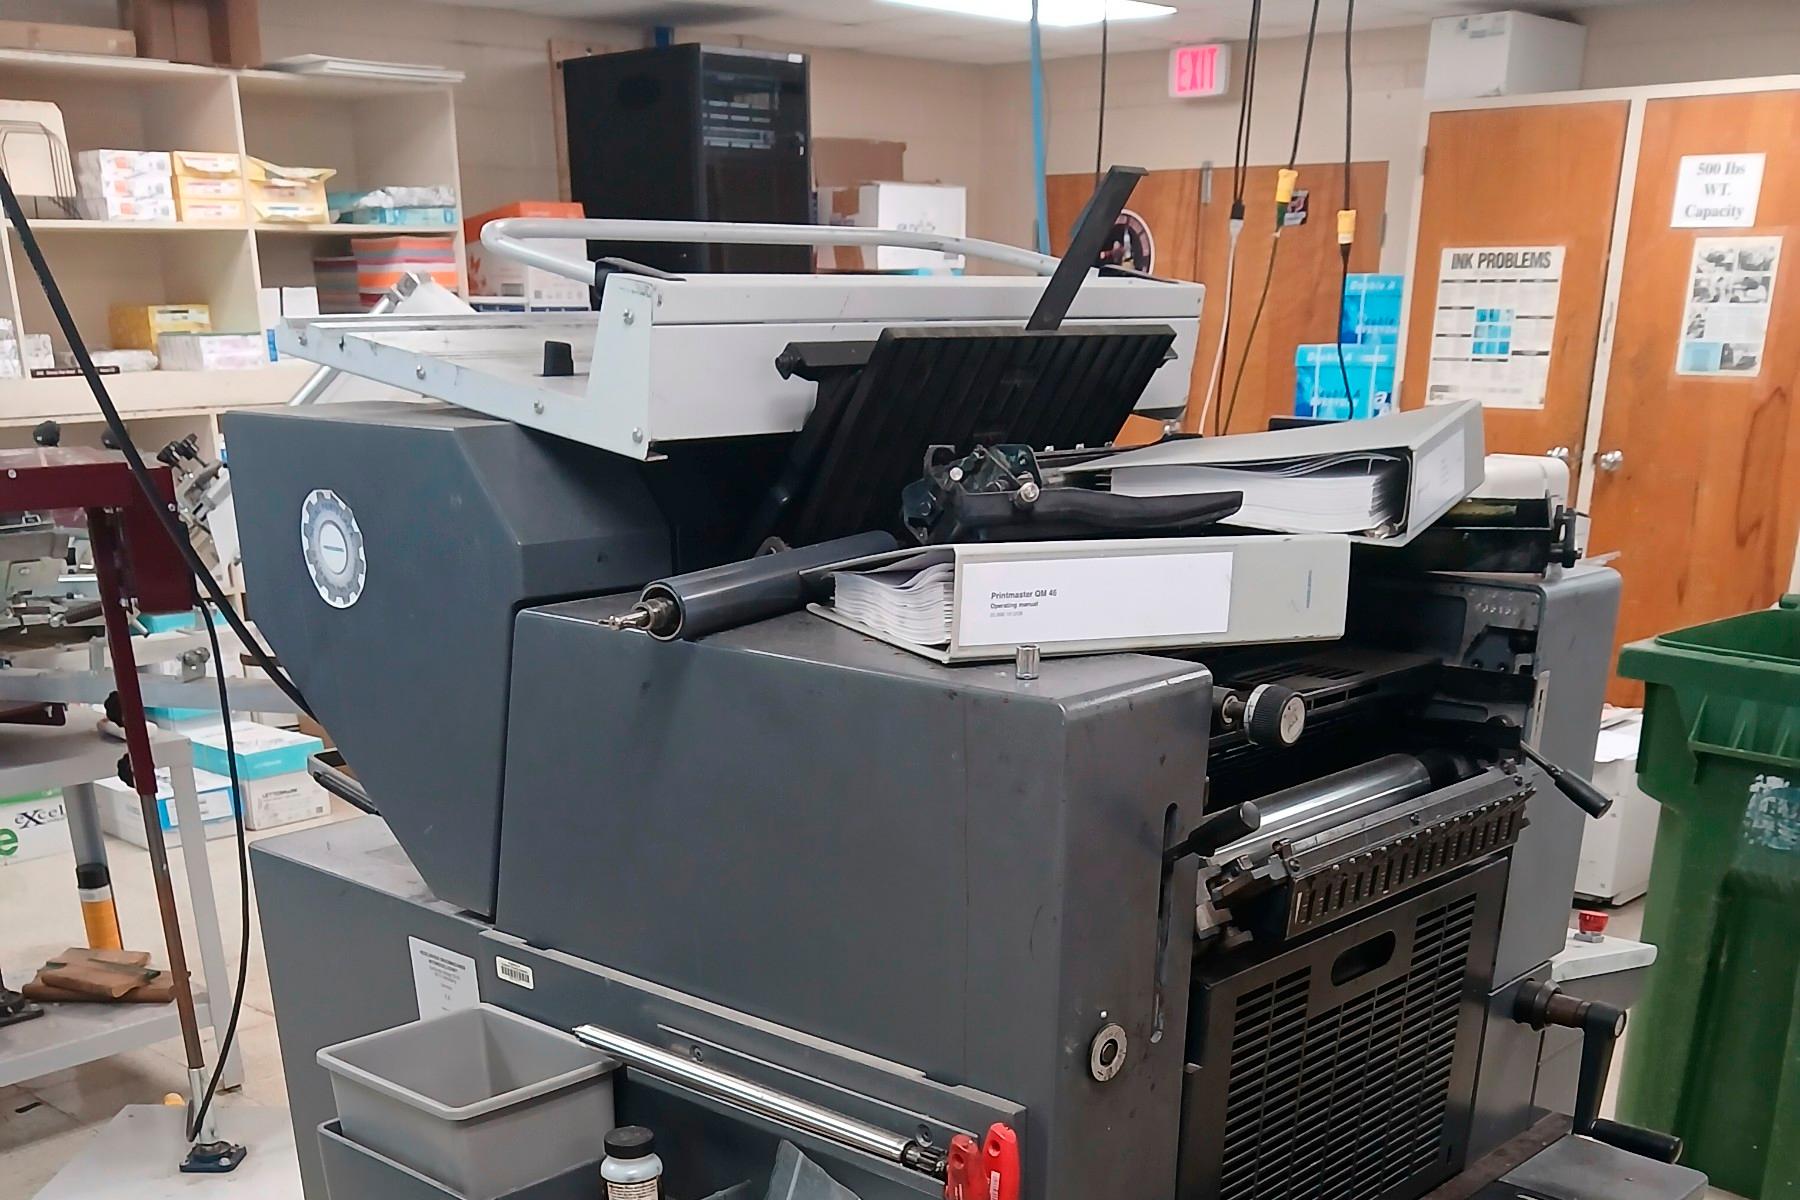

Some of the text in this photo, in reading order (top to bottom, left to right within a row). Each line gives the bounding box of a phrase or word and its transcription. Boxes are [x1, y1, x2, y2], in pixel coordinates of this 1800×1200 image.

[1177, 47, 1217, 92] EXIT
[1696, 161, 1721, 176] 500
[1684, 204, 1744, 221] Capacity
[1451, 251, 1551, 270] INK PROBLEMS
[991, 591, 1033, 599] Printmaster
